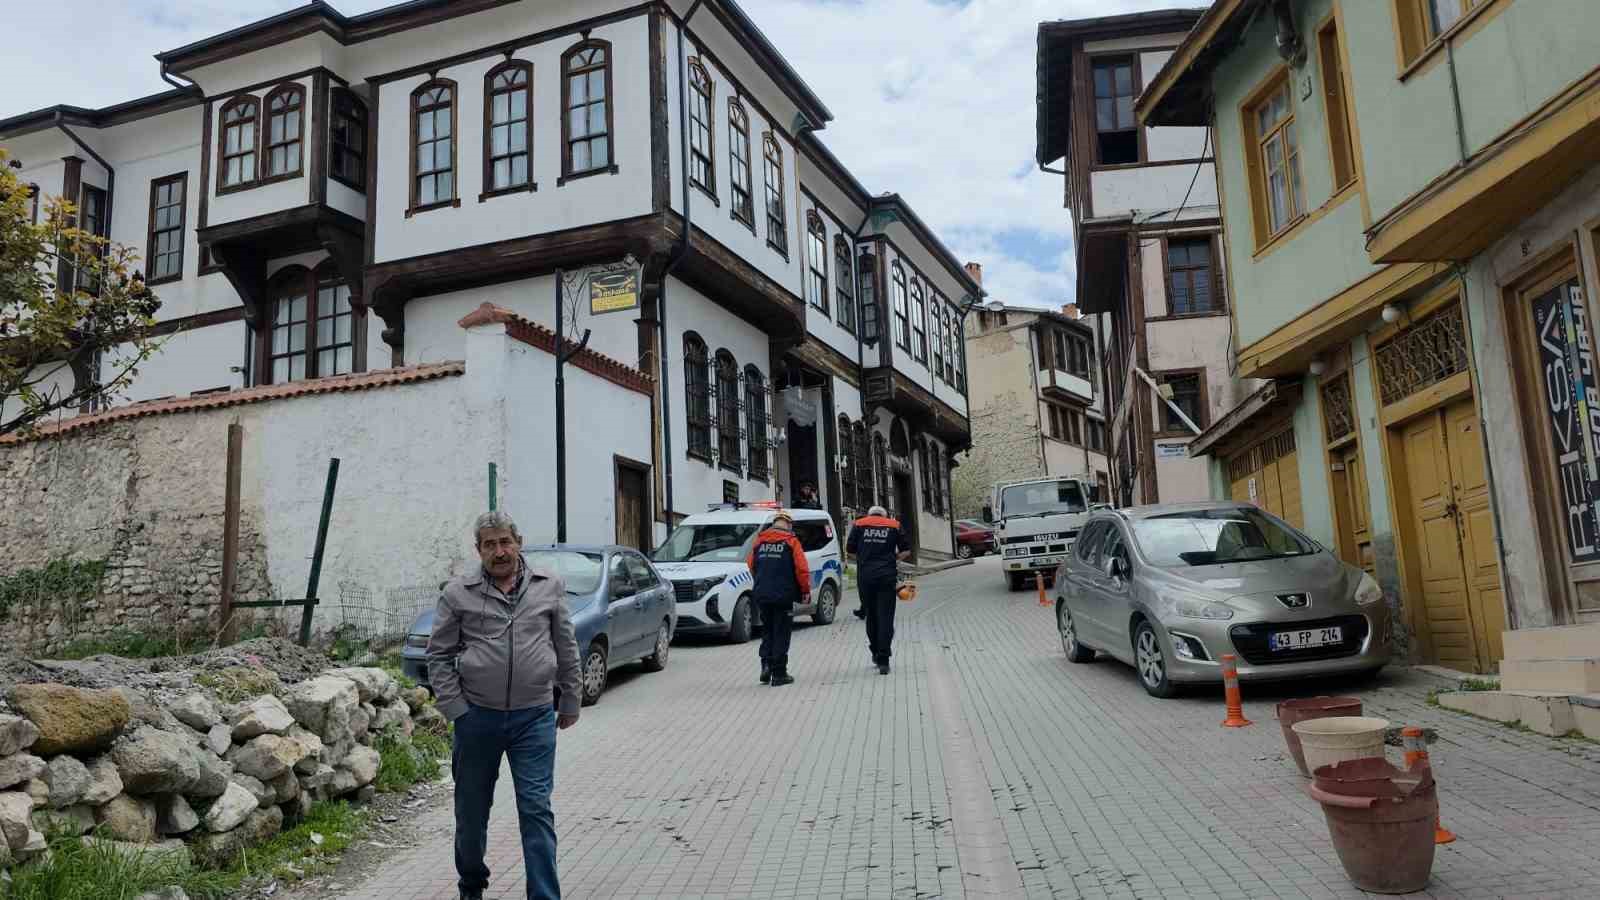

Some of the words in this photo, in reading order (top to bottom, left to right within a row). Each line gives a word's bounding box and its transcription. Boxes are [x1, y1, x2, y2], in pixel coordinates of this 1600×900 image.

[864, 528, 888, 537] AFAD
[759, 543, 784, 552] AFAD
[1278, 633, 1290, 646] 43
[1299, 631, 1311, 643] FP
[1320, 628, 1338, 641] 214
